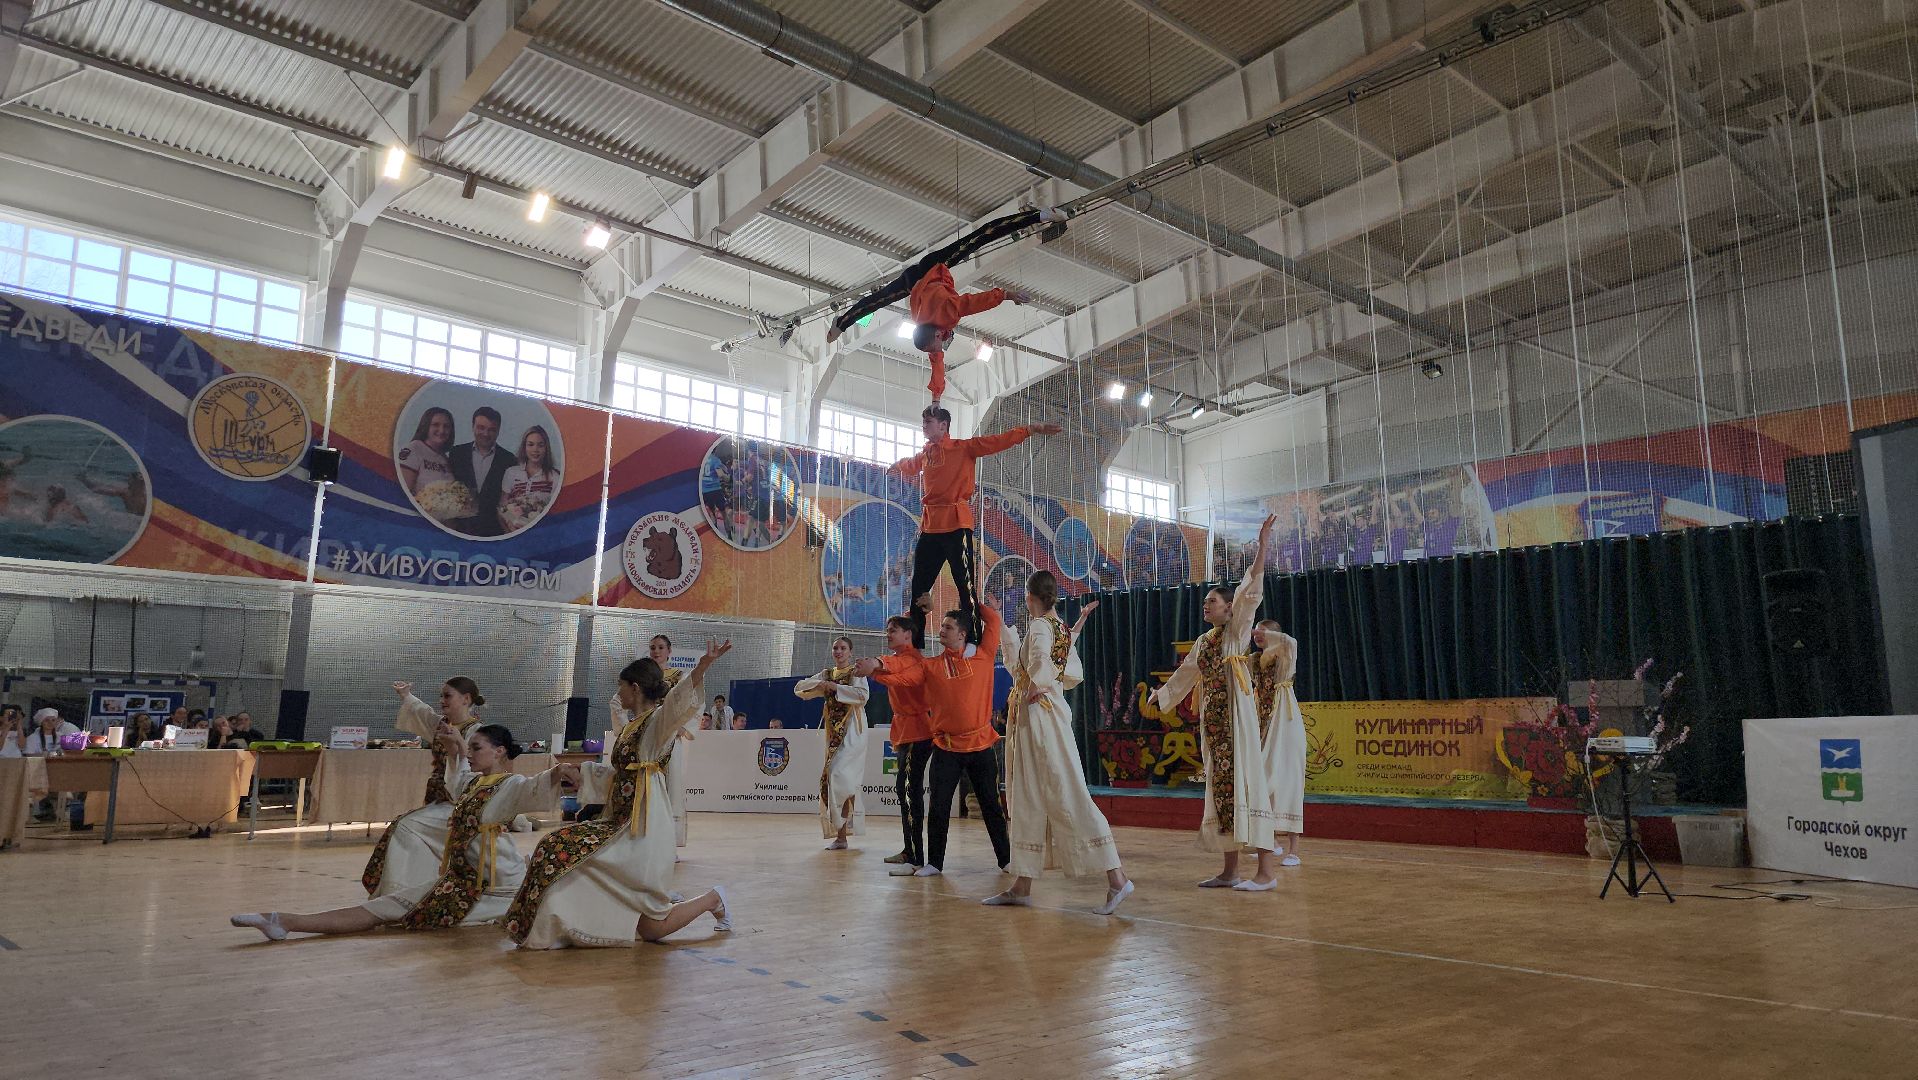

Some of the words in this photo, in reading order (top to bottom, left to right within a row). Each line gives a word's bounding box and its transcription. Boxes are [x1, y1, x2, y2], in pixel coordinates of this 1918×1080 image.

[333, 549, 562, 591] #ЖИВУСПОРТОМ
[627, 562, 668, 596] МОСКОВСКАЯ
[1355, 715, 1483, 734] КУЛИНАРНЫЙ
[1355, 740, 1461, 757] ПОЕДИНОК
[1381, 763, 1412, 771] КОМАНД
[1390, 772, 1450, 780] ОЛИМПИЙСКОГО
[754, 782, 789, 791] Училище
[1787, 816, 1860, 835] Городской
[1865, 824, 1907, 840] округ
[1824, 841, 1868, 860] Чехов
